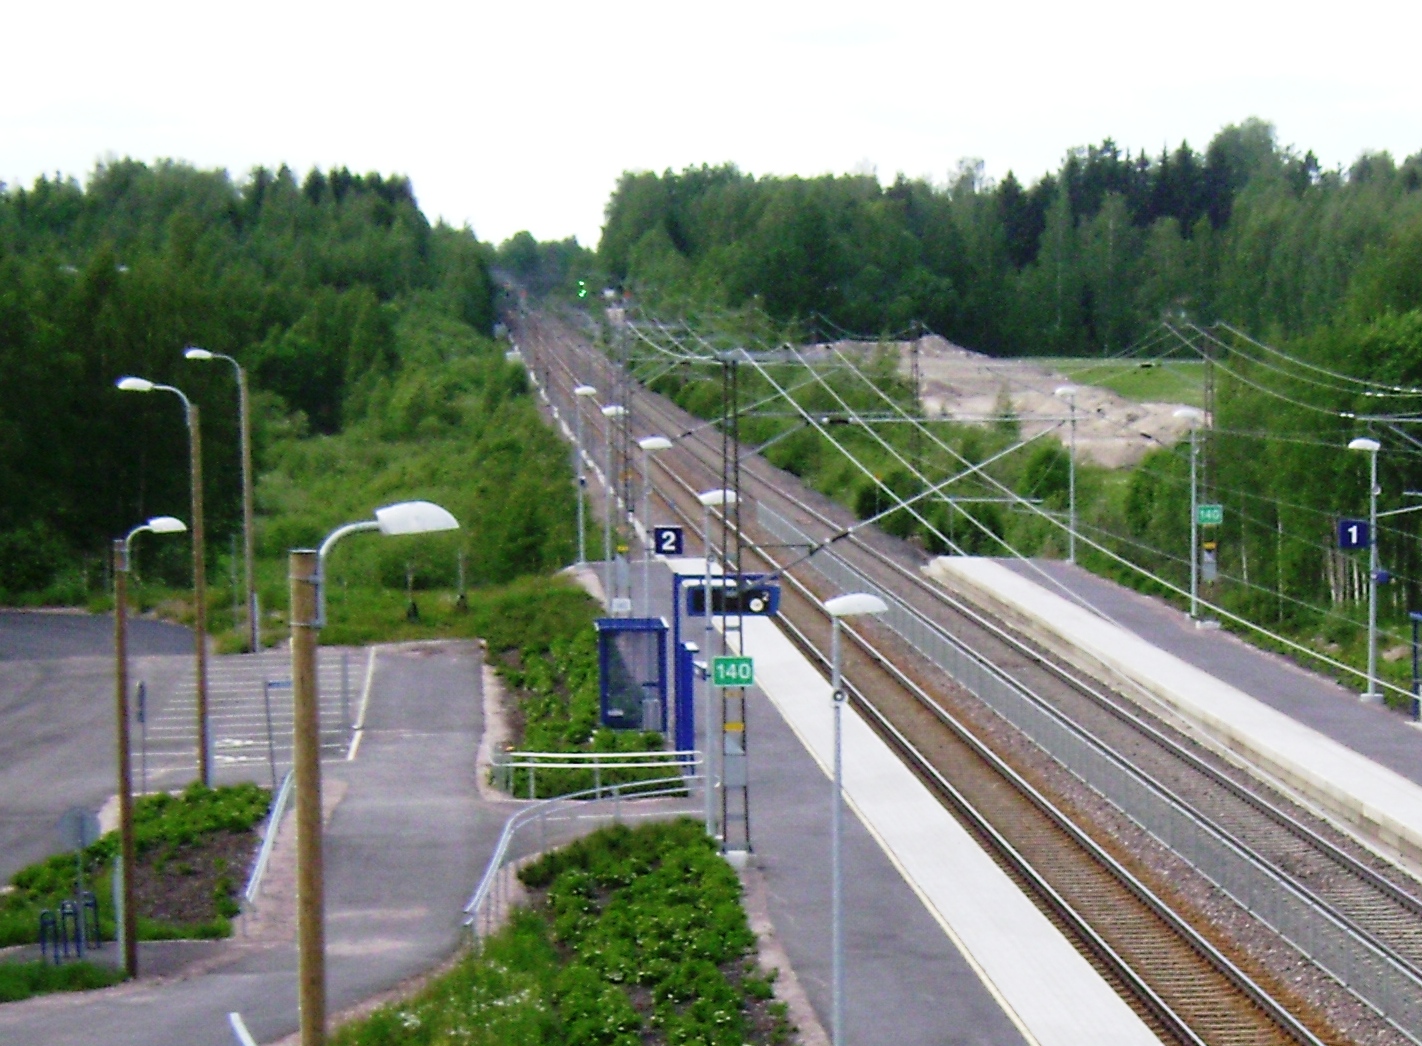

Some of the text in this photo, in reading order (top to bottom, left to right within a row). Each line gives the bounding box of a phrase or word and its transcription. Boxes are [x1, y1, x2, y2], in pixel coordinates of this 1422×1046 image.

[661, 531, 676, 551] 2
[1347, 525, 1357, 544] 1
[716, 664, 752, 679] 140
